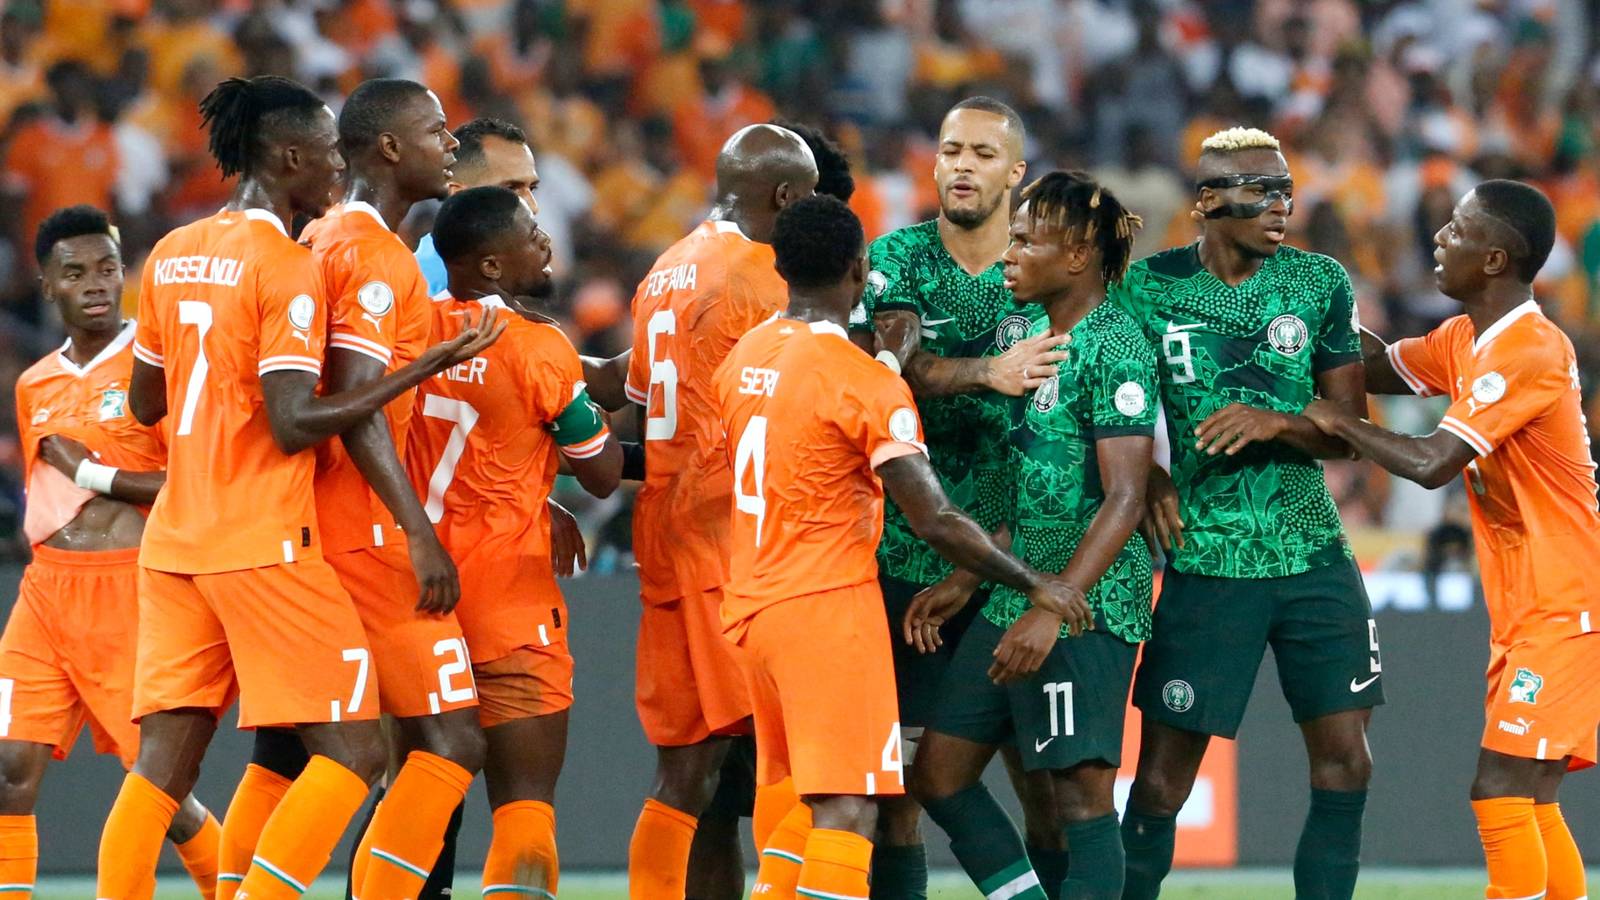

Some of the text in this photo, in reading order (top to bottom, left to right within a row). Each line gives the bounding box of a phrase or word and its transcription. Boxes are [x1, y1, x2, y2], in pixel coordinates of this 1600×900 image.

[643, 264, 697, 300] FOFANA
[176, 300, 214, 436] 7
[645, 309, 678, 441] 6
[738, 366, 780, 397] SERI
[1162, 332, 1196, 383] 9
[422, 393, 480, 524] 7
[734, 416, 768, 548] 4
[341, 647, 369, 713] 7
[1042, 681, 1075, 737] 11
[881, 721, 904, 785] 4
[1498, 719, 1526, 736] PUMA
